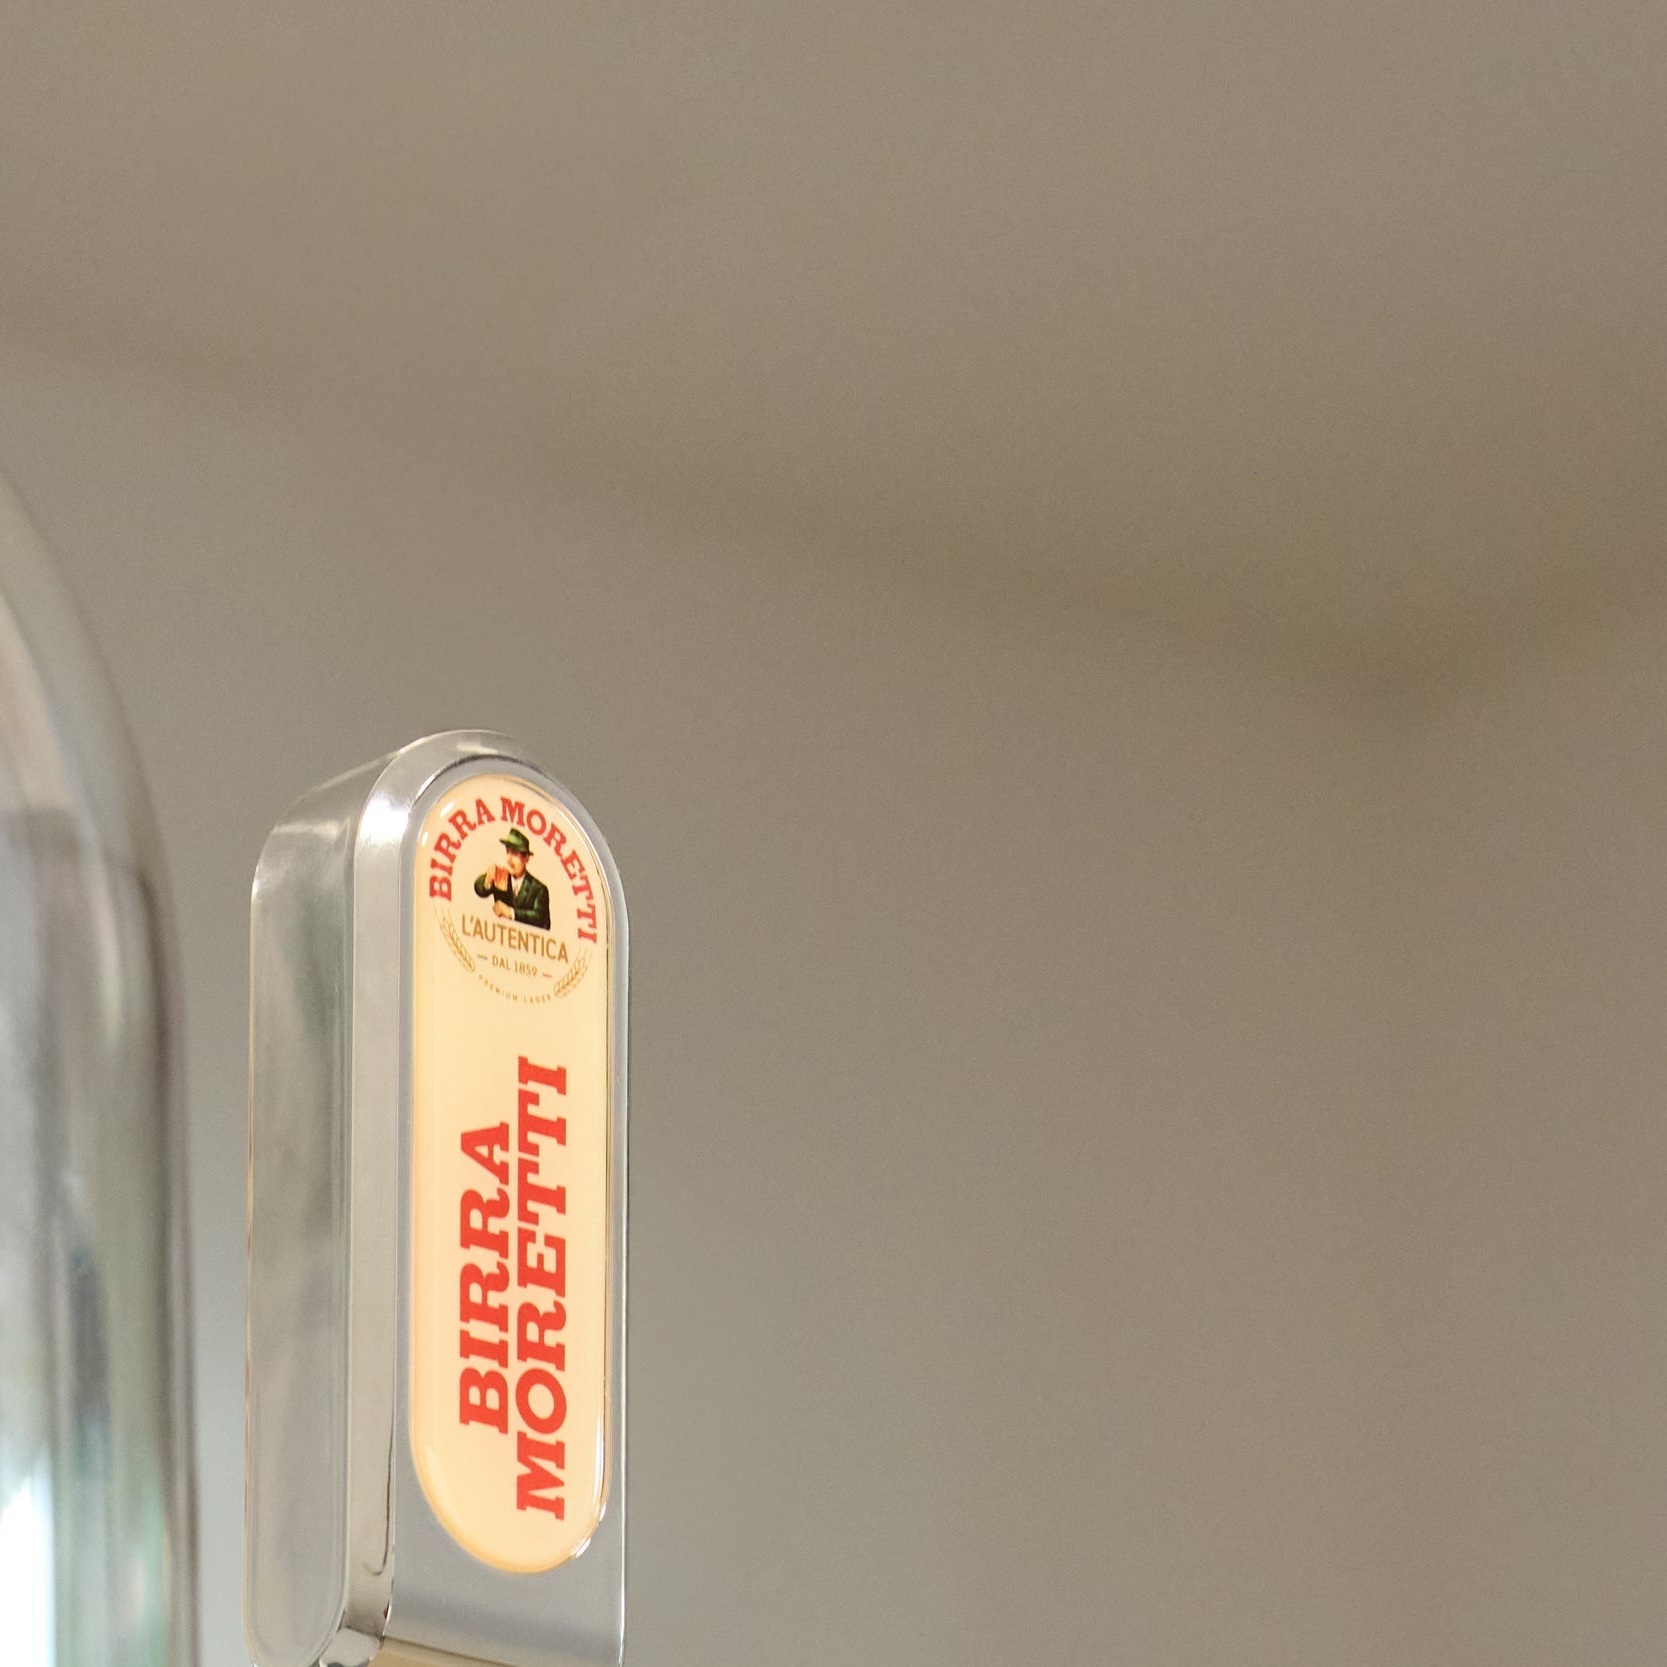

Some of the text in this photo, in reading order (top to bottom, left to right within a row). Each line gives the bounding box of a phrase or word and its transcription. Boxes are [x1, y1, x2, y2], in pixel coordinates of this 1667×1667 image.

[429, 796, 598, 944] BIRRA MORETTI
[461, 914, 569, 964] L'AUTENTICA
[492, 954, 538, 977] DAL 1859
[460, 1121, 510, 1435] BIRRA
[515, 1056, 567, 1521] MORETTI
